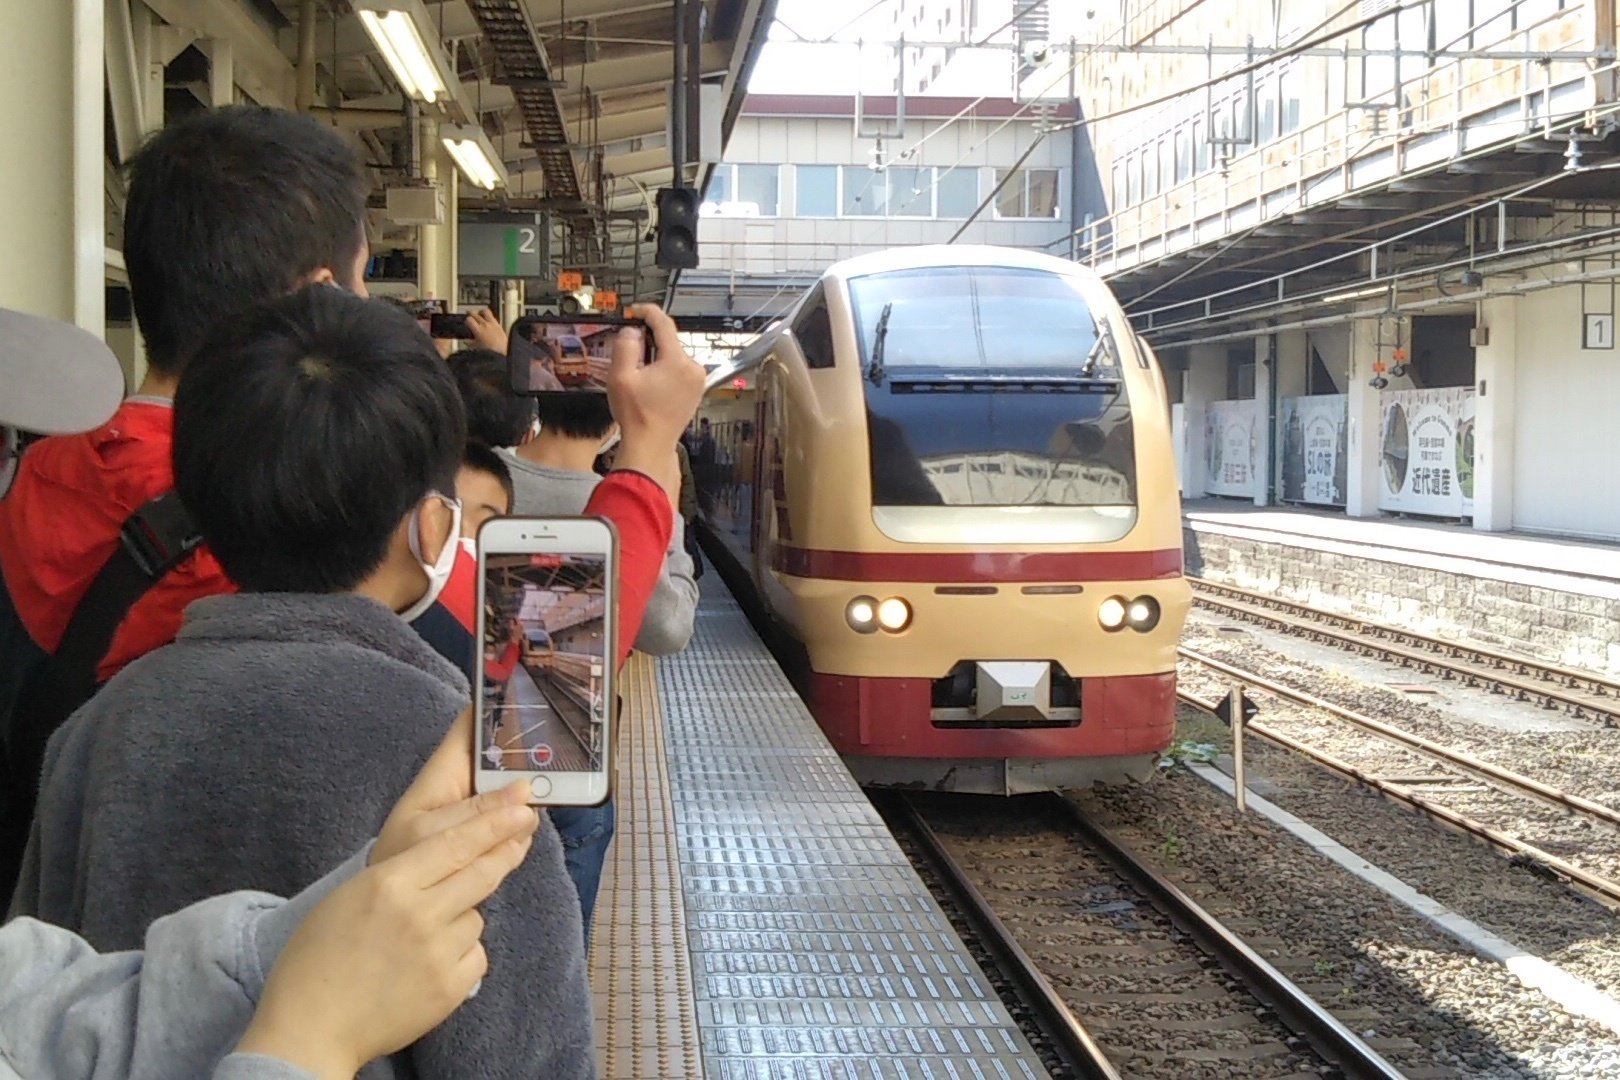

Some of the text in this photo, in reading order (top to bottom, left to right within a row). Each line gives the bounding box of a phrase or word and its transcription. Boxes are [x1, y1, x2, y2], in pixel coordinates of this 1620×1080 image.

[519, 228, 535, 253] 2
[1594, 320, 1603, 344] 1
[1412, 467, 1451, 496] 近代遺産
